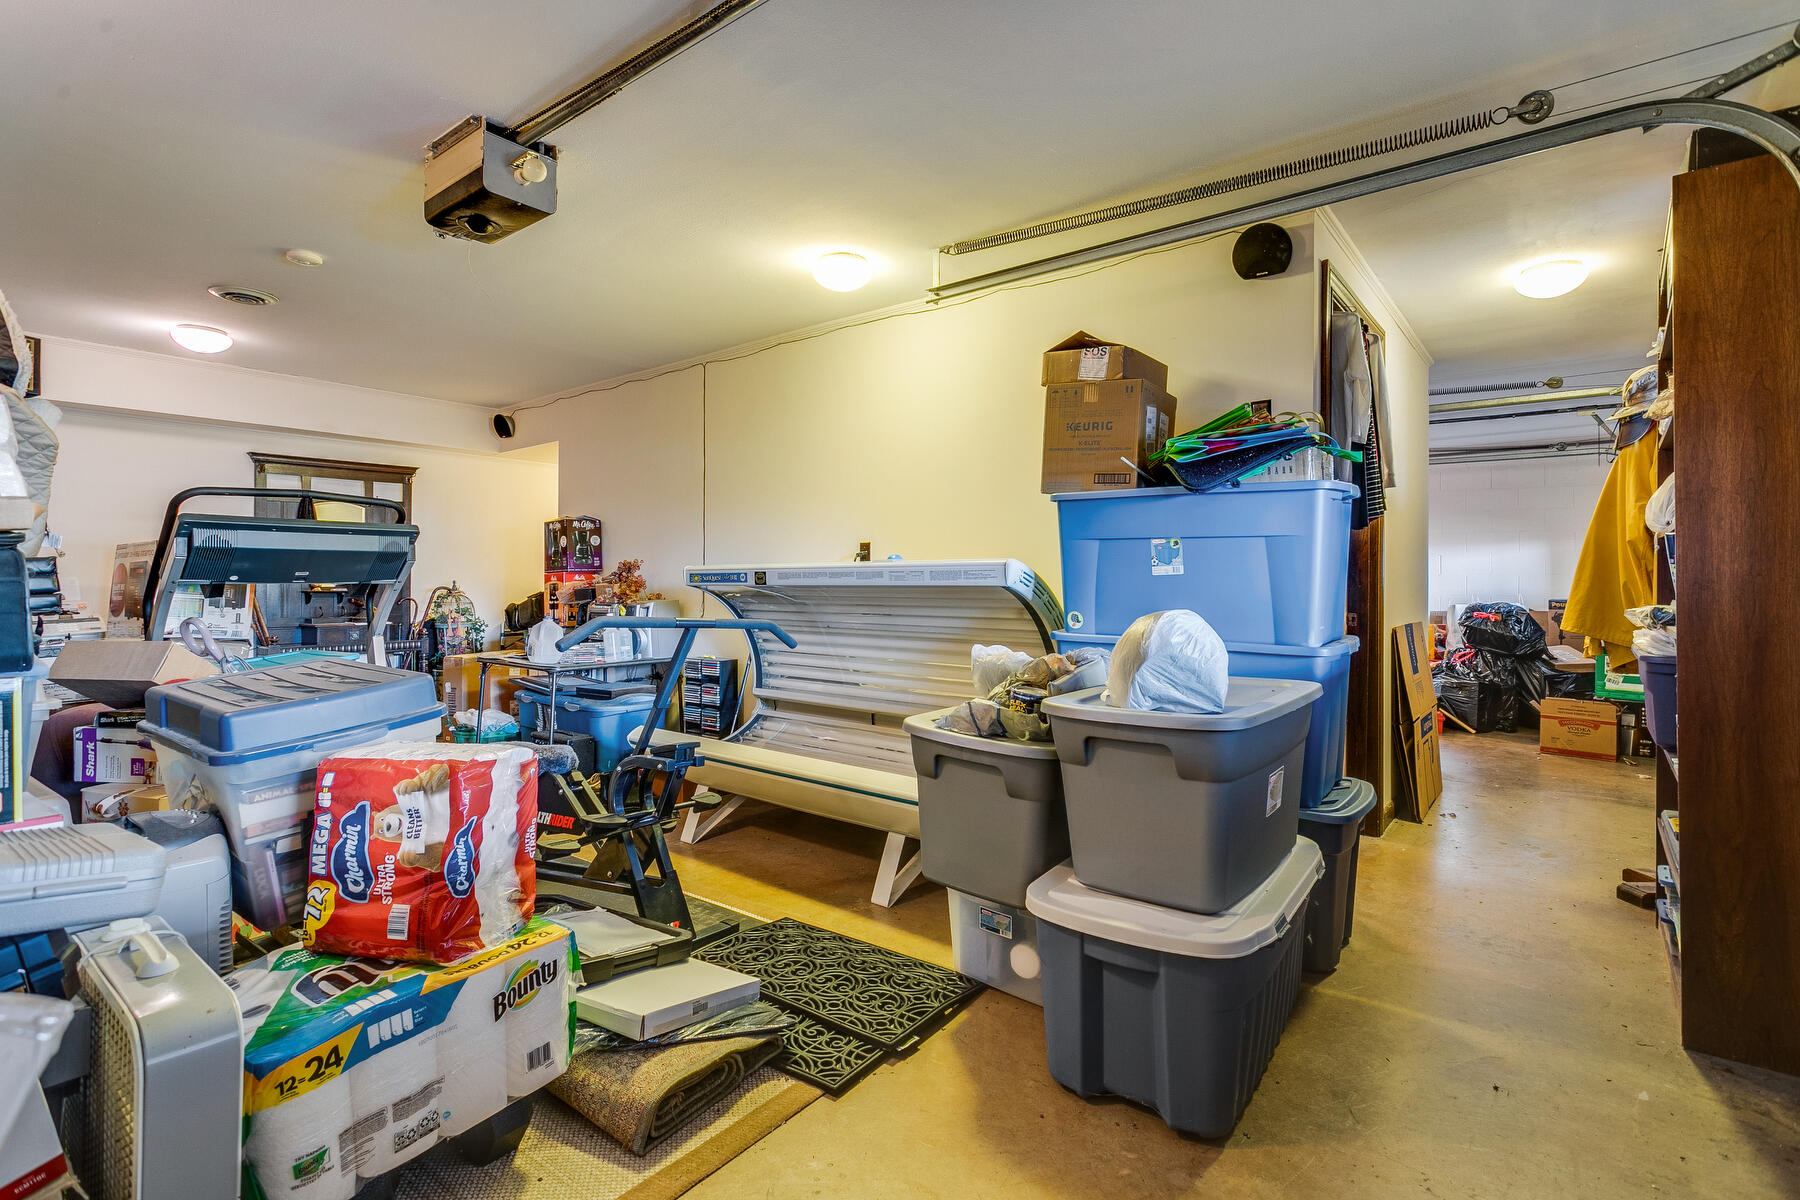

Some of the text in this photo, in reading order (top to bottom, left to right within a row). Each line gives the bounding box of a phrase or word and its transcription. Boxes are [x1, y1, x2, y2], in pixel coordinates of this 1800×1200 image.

[1065, 421, 1113, 432] KEURIG
[85, 741, 95, 777] Shark
[311, 811, 333, 876] MEGA
[406, 808, 414, 840] CLEANS
[414, 808, 423, 840] BETTER
[344, 823, 365, 894] Charmin
[373, 864, 386, 896] ULTRA
[381, 854, 396, 905] STRONG
[456, 836, 470, 891] Charmin
[492, 959, 558, 1023] Bounty
